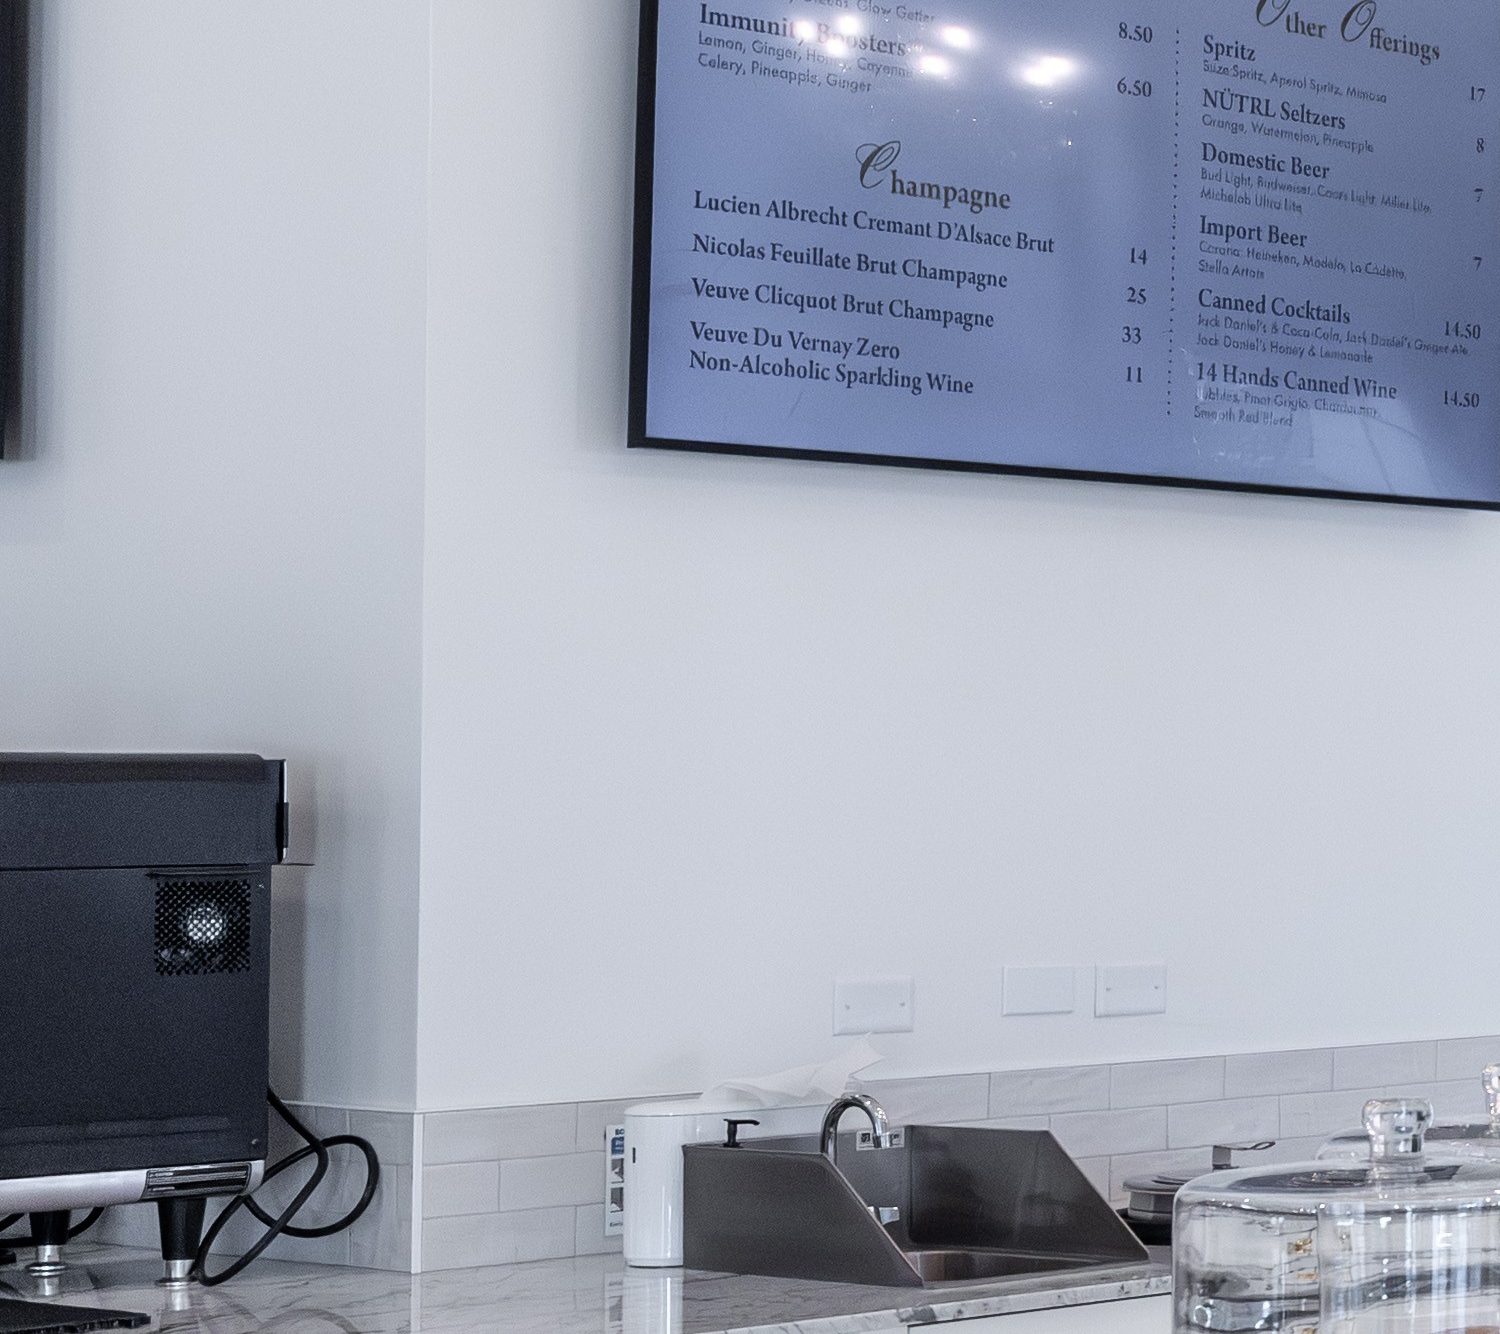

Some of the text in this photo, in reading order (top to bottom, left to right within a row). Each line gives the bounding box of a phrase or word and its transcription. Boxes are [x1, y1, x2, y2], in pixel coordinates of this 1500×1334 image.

[699, 3, 805, 46] Immuni
[1118, 22, 1153, 43] 8.50
[698, 30, 746, 54] Lemon,
[751, 40, 802, 62] Ginger,
[1202, 34, 1256, 62] Spritz
[698, 53, 872, 93] Celery, Pineapple, Ginger
[1117, 77, 1152, 97] 6.50
[1270, 71, 1307, 90] Aperol
[1346, 87, 1387, 104] Mimosa
[1470, 86, 1486, 102] 17
[1202, 87, 1346, 130] NÜTRL Seltzers
[1201, 114, 1247, 134] Orange,
[1322, 133, 1375, 154] Pineapple
[1476, 137, 1485, 154] 8
[1201, 141, 1330, 179] Domestic Beer
[855, 140, 1011, 214] Champagne
[1201, 167, 1222, 182] Bud
[1200, 186, 1251, 205] Michelob
[1255, 193, 1281, 210] Ultra
[1474, 188, 1485, 203] 7
[694, 190, 761, 216] Lucien
[765, 199, 848, 228] Albrecht
[853, 210, 931, 239] Cremant
[1016, 232, 1055, 253] Brut
[1200, 215, 1308, 248] Import Beer
[692, 233, 1008, 292] Nicolas Feuillate Brut Champagne
[1129, 247, 1148, 265] 14
[1350, 261, 1362, 273] La
[1473, 256, 1482, 271] 7
[1198, 258, 1265, 280] Stella Artois
[691, 277, 995, 332] Veuve Clicquot Brut Champagne
[1126, 287, 1148, 304] 25
[1198, 288, 1351, 325] Canned Cocktails
[690, 321, 900, 359] Veuve Du Vernay Zero
[1122, 326, 1142, 344] 33
[1197, 313, 1219, 327] Jack
[1271, 322, 1279, 334] &
[1346, 330, 1367, 345] Jack
[1443, 320, 1481, 340] 14.50
[1196, 333, 1218, 346] Jack
[1270, 340, 1305, 358] Honey
[1308, 345, 1316, 357] &
[689, 349, 974, 395] Non-Alcoholic Sparkling Wine
[1125, 366, 1143, 383] 11
[1196, 361, 1397, 400] 14 Hands Canned Wine
[1244, 391, 1271, 405] Pinot
[1443, 390, 1480, 408] 14.50
[1238, 410, 1259, 424] Red
